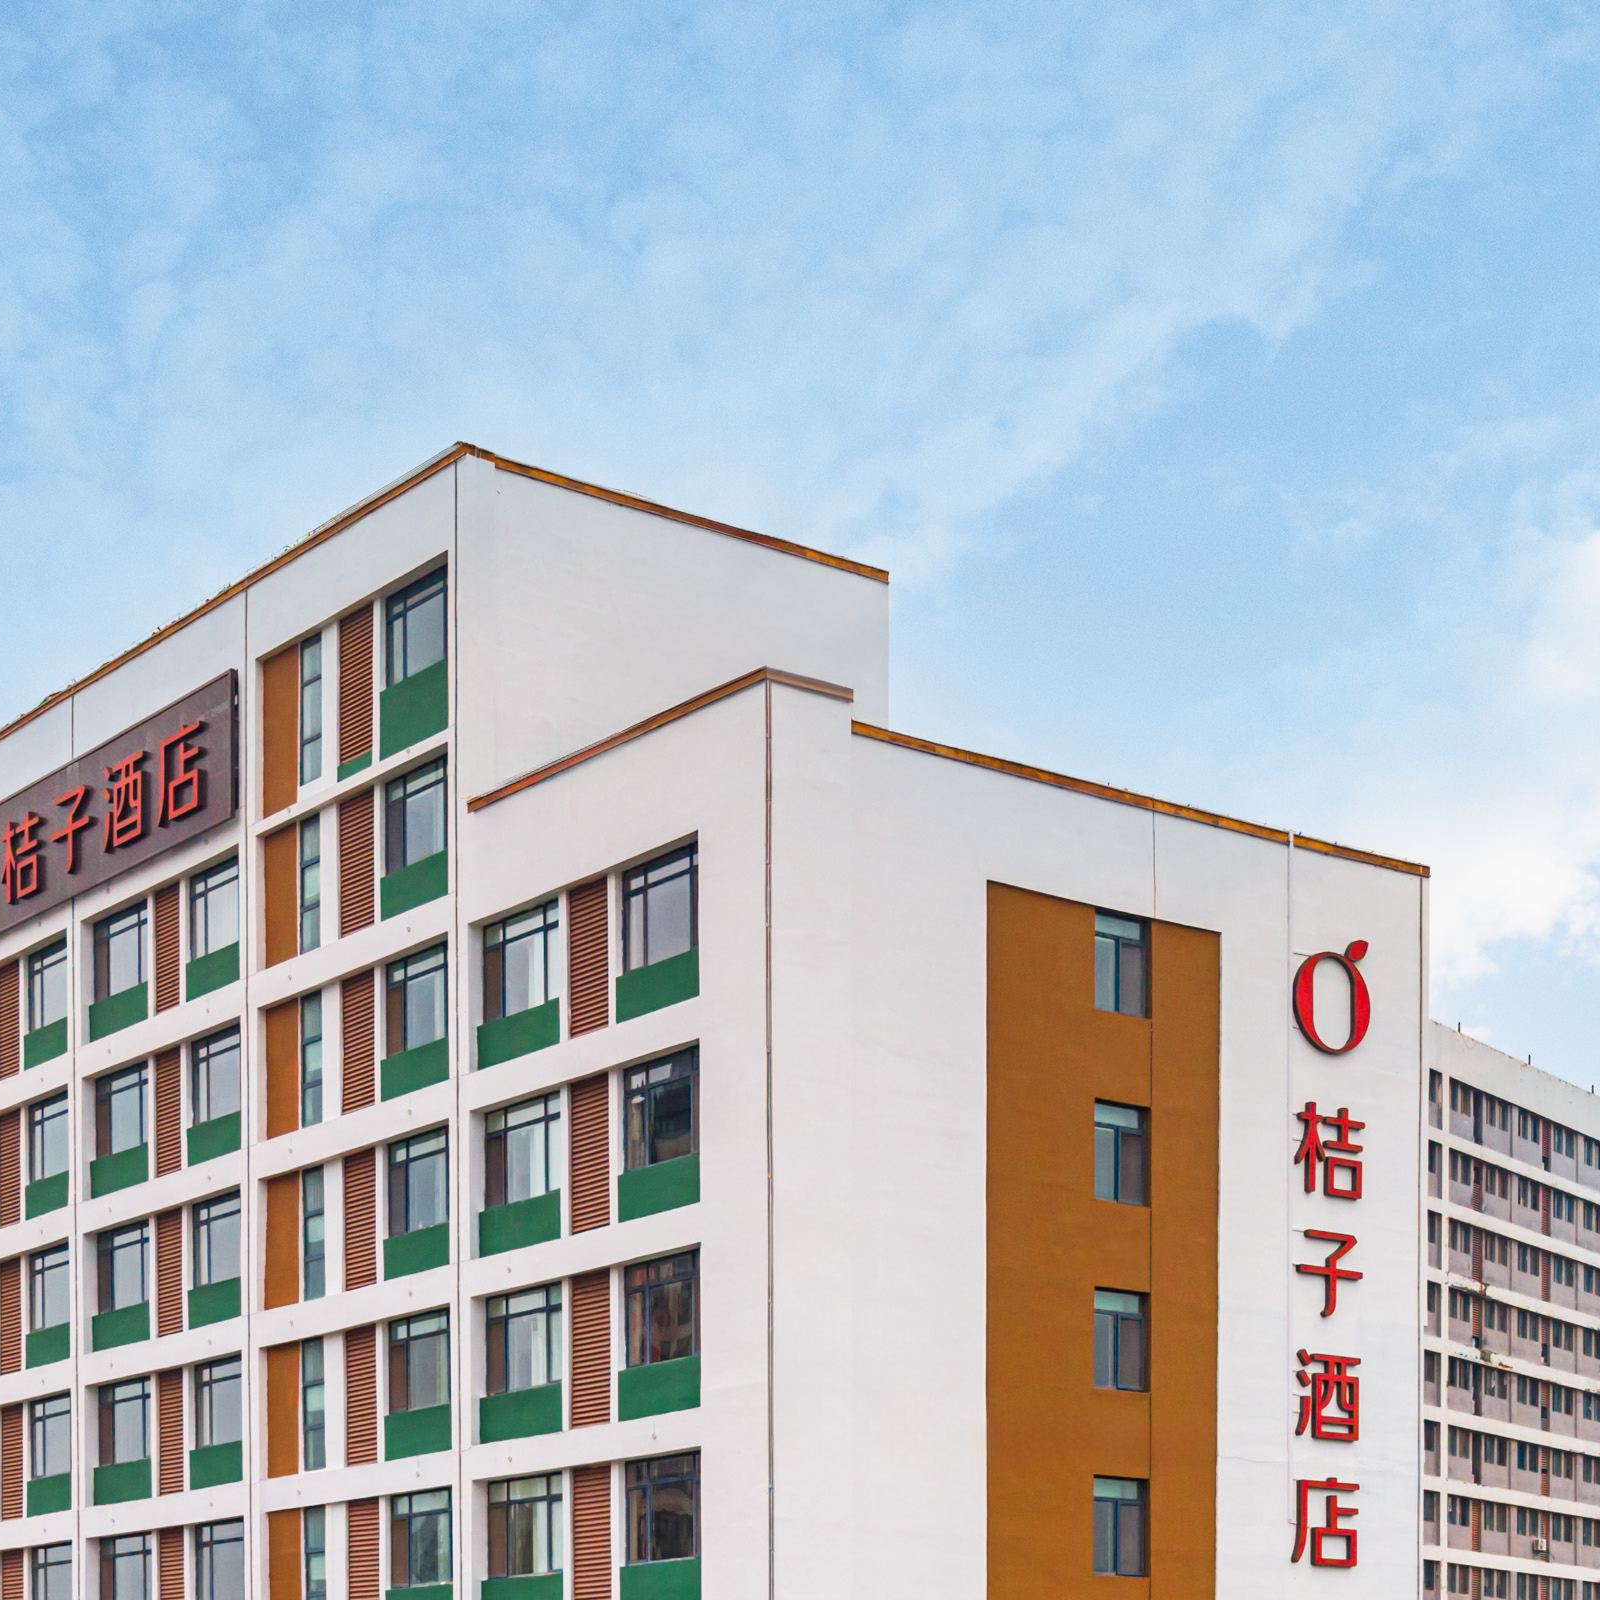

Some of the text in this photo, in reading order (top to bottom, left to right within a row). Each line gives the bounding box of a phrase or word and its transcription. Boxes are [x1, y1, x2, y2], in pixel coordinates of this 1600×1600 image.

[2, 720, 206, 905] 桔子酒店
[1291, 1101, 1366, 1569] 桔子酒店
